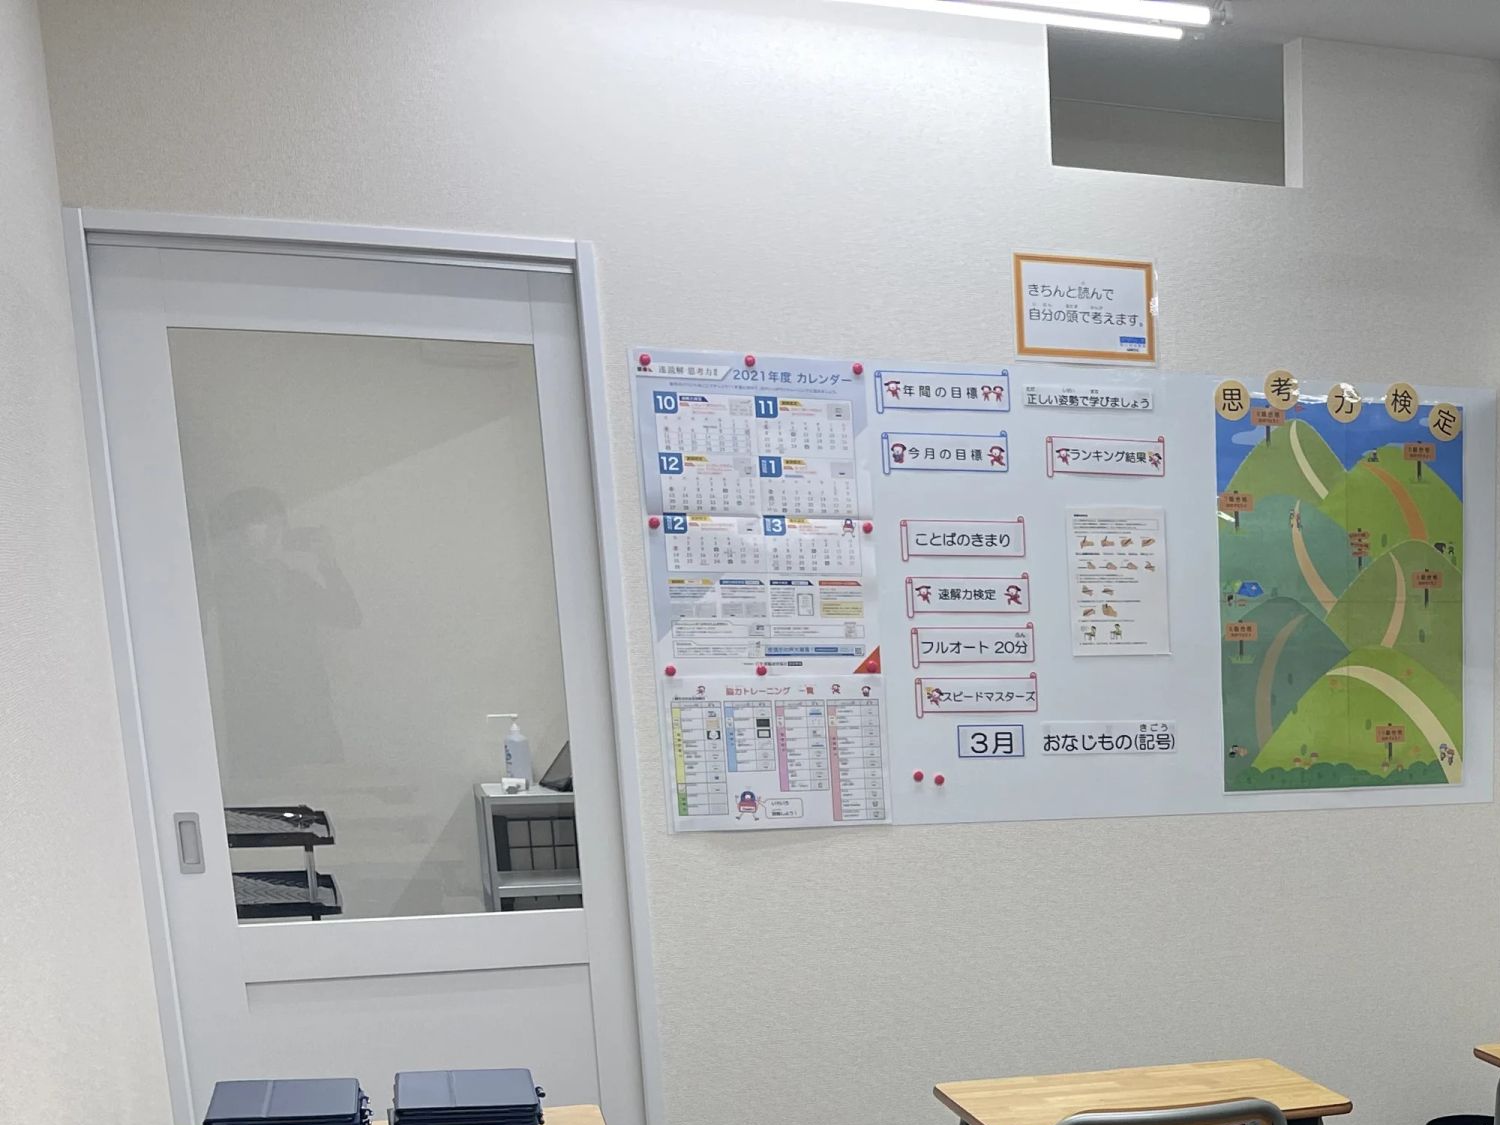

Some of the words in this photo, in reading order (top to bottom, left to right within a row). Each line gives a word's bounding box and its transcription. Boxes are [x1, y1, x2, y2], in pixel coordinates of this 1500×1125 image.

[1028, 284, 1114, 301] きちんと読んで
[1029, 308, 1144, 328] 自分の頭で考えます。
[732, 369, 792, 384] 2021年度
[796, 371, 853, 386] カレンダー
[902, 384, 979, 400] 年間の目標
[655, 395, 676, 410] 10
[758, 399, 774, 415] 11
[1026, 392, 1151, 410] 正しい姿勢で学びましょう
[1222, 377, 1456, 436] 思考力検定
[907, 446, 983, 462] 今月の目標
[1069, 449, 1148, 464] ランキング結果
[660, 456, 680, 471] 12
[769, 459, 776, 474] 1
[672, 516, 685, 531] 2
[771, 518, 783, 533] 3
[915, 532, 1011, 548] ことばのきまり
[937, 588, 997, 602] 速解力検定
[921, 641, 989, 655] フルオート
[994, 640, 1028, 655] 20分
[942, 690, 1036, 703] スピードマスターズ
[1139, 723, 1169, 732] きごう
[970, 731, 1014, 755] 3月
[1043, 733, 1175, 752] おなじもの(記号)
